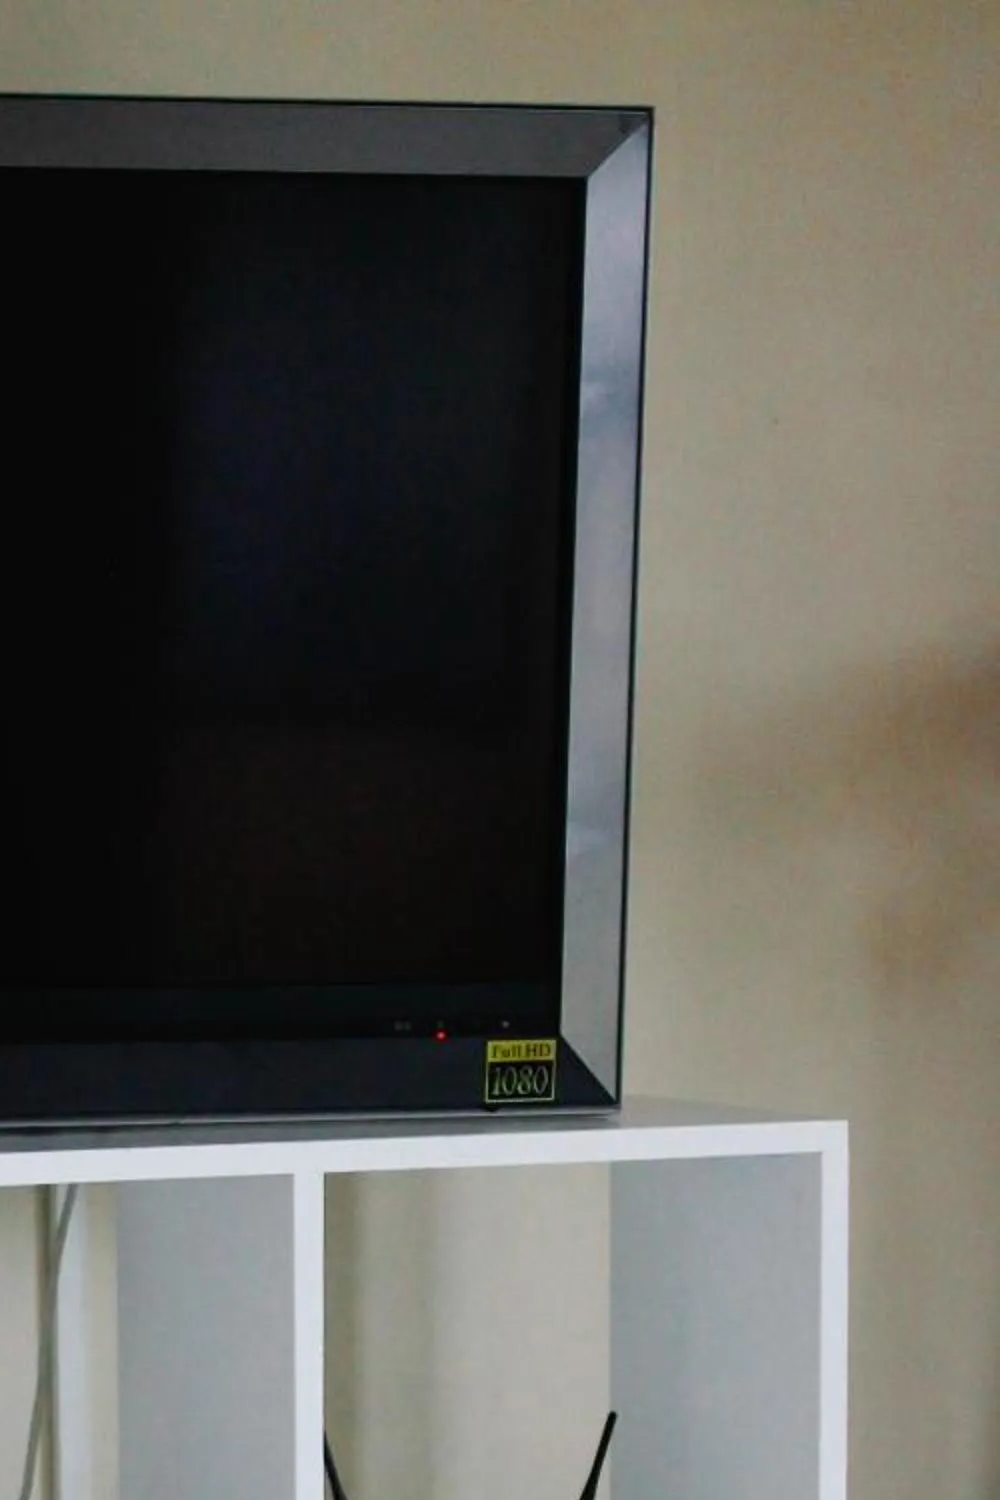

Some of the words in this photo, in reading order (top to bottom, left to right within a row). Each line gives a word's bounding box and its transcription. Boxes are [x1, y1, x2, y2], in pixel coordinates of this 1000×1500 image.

[491, 1043, 522, 1059] Full
[525, 1042, 552, 1058] HD
[491, 1064, 550, 1097] 1080
